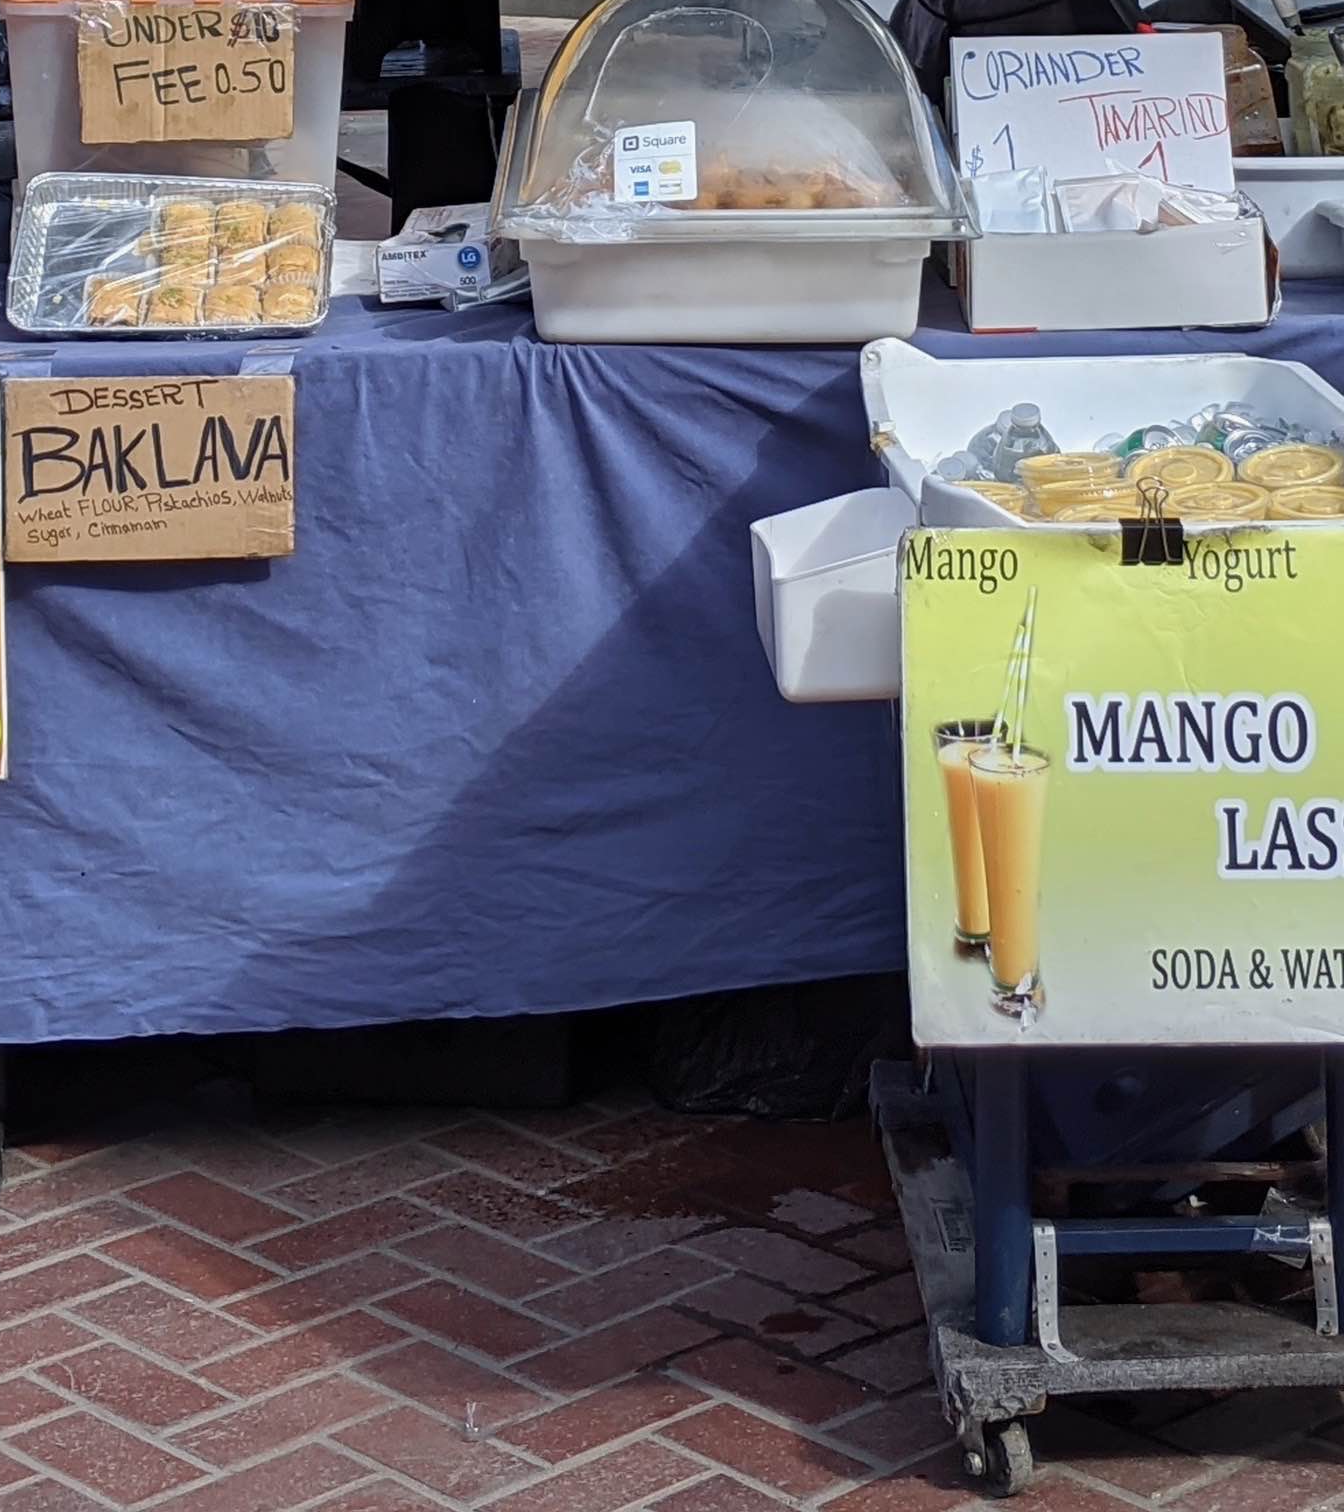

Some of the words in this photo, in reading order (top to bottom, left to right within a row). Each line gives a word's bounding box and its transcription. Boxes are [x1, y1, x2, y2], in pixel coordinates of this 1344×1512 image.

[104, 10, 223, 47] UNDER
[113, 59, 207, 105] FEE
[214, 58, 285, 94] 0.50
[961, 46, 1145, 100] CORIANDER
[1059, 89, 1229, 150] TAMARIND
[642, 134, 687, 148] Square
[629, 165, 652, 173] VISA
[461, 252, 477, 262] LG
[460, 277, 476, 286] 500
[50, 379, 218, 415] DESSERT
[12, 415, 290, 505] BAKLAVA
[18, 504, 72, 525] Wheat
[904, 538, 1019, 594] Mango
[1181, 538, 1297, 592] Yogurt
[1071, 699, 1309, 764] MANGO
[1151, 948, 1238, 990] SODA
[1248, 949, 1274, 990] &
